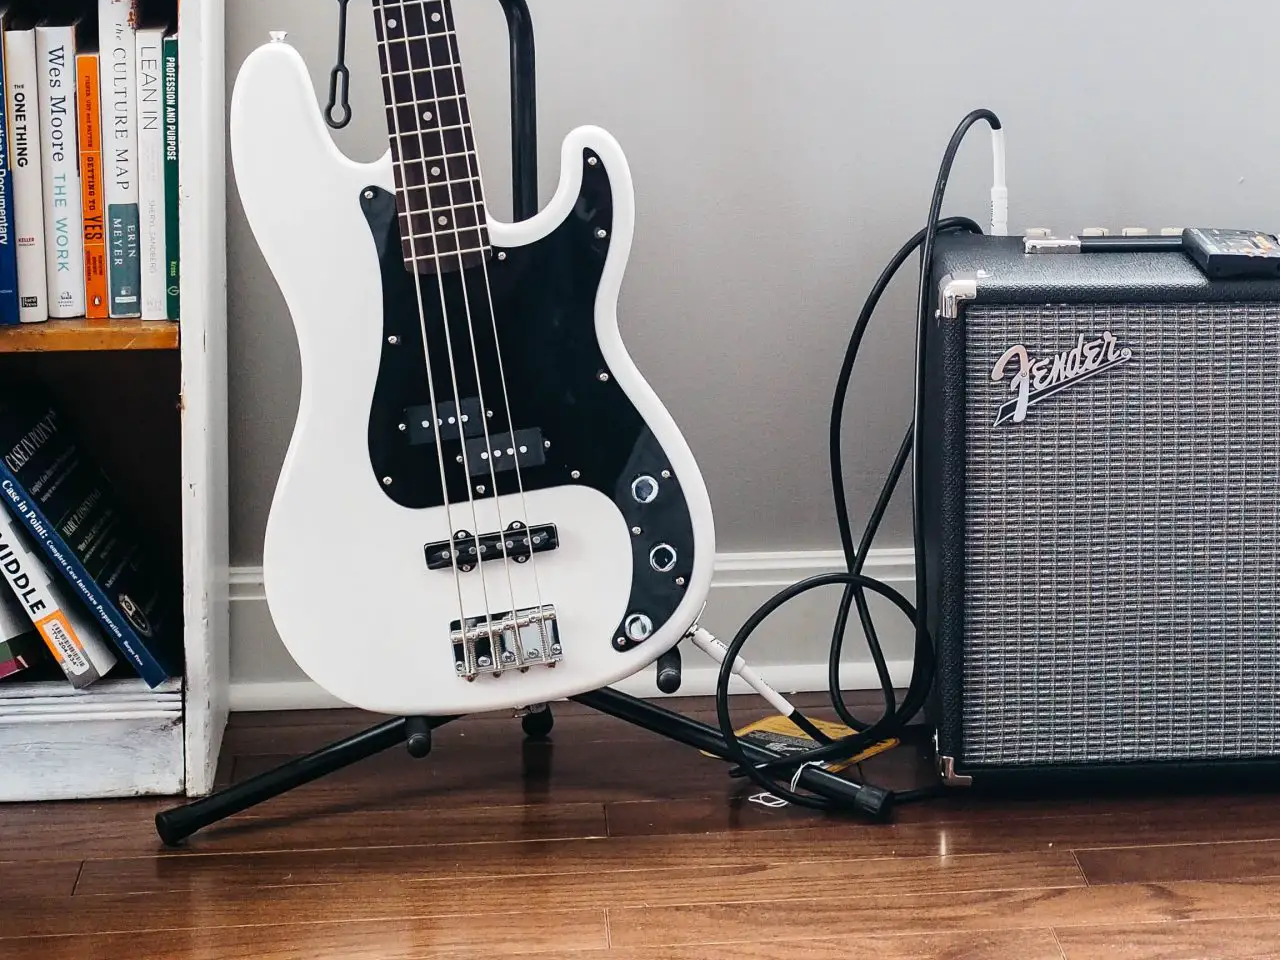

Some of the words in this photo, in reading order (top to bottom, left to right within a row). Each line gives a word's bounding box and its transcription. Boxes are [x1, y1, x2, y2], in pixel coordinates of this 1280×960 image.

[48, 44, 65, 88] Wes
[141, 46, 157, 102] LEAN
[165, 56, 176, 105] PROFESSION
[14, 92, 26, 122] ONE
[112, 46, 130, 140] CULTURE
[166, 106, 177, 123] AND
[49, 95, 67, 162] Moore
[142, 111, 158, 131] IN
[166, 123, 177, 161] PURPOSE
[15, 124, 29, 168] THING
[54, 173, 67, 208] THE
[86, 156, 96, 196] GETTING
[115, 148, 130, 191] MAP
[88, 197, 97, 211] TO
[54, 217, 70, 273] WORK
[84, 215, 103, 241] YES
[113, 218, 123, 266] MEYER
[127, 224, 137, 258] ERIN
[990, 330, 1121, 423] Fender
[5, 443, 29, 473] CASE
[2, 479, 20, 503] Case
[17, 500, 29, 514] in
[25, 510, 49, 540] Point:
[46, 539, 68, 568] Complete
[65, 564, 79, 581] Case
[76, 576, 99, 607] Interview
[96, 604, 123, 639] Preparation
